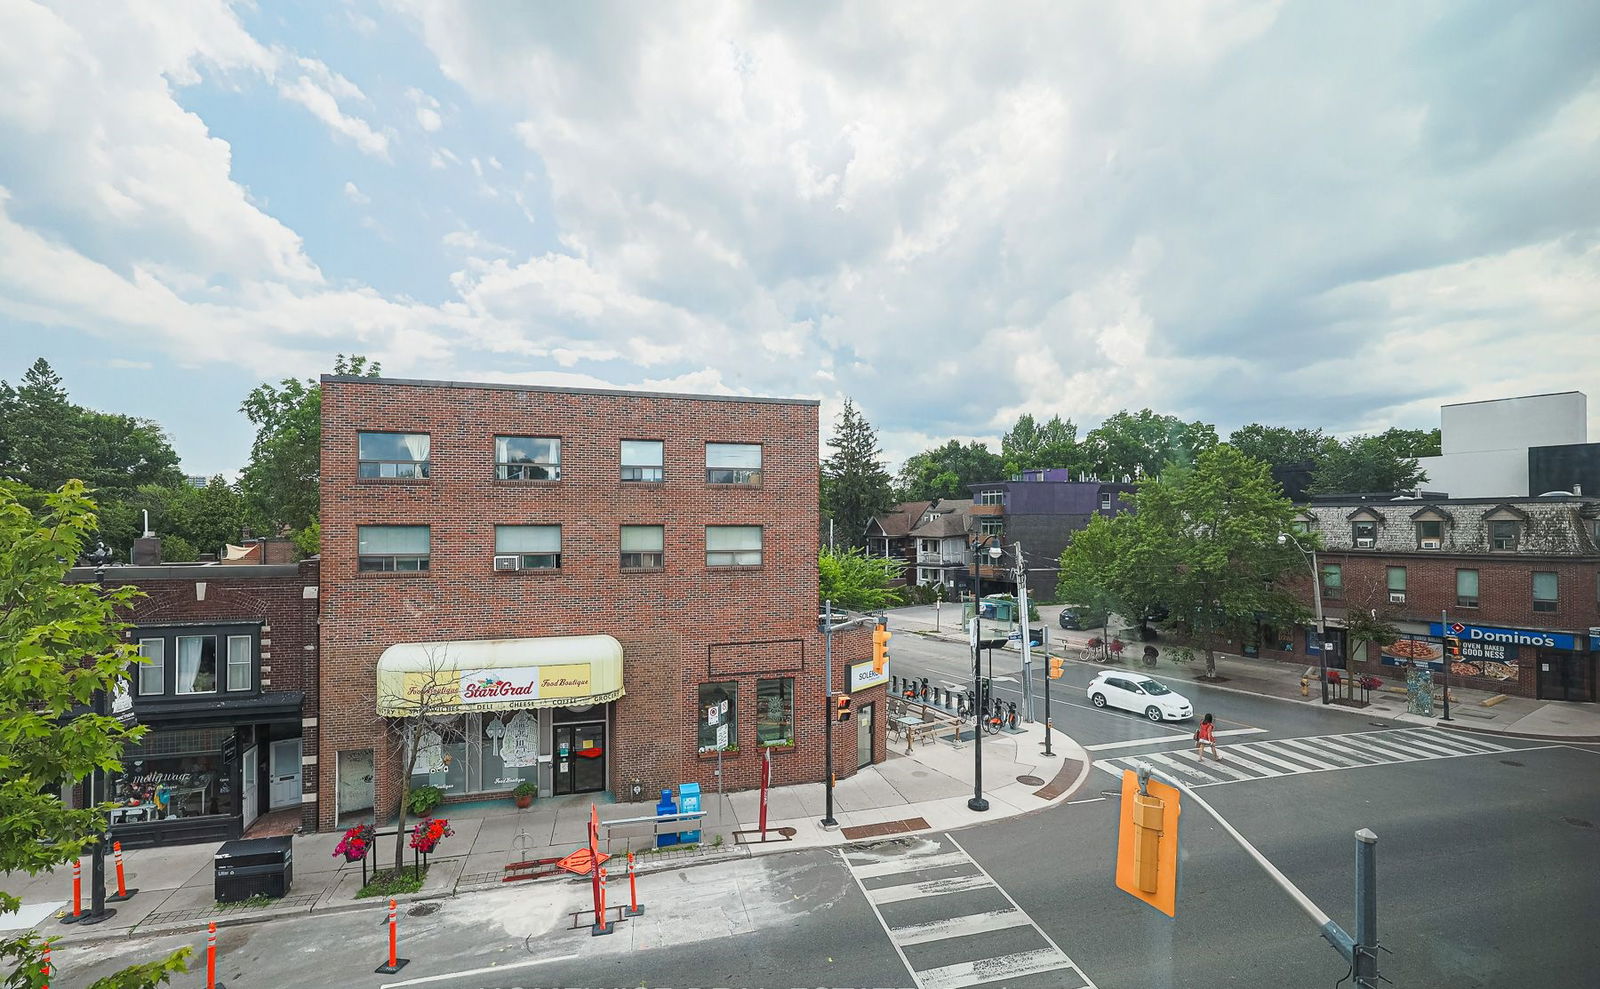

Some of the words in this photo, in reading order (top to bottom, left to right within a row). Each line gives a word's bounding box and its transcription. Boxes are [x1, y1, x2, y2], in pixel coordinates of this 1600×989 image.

[1470, 628, 1555, 647] Domino's
[1462, 648, 1483, 656] GOOD
[1484, 650, 1505, 659] NESS
[1484, 644, 1505, 652] BAKED
[541, 679, 559, 687] Food
[558, 678, 589, 688] Boutique
[464, 683, 499, 698] Stari
[499, 681, 534, 697] Grad
[594, 690, 620, 702] GROCERY
